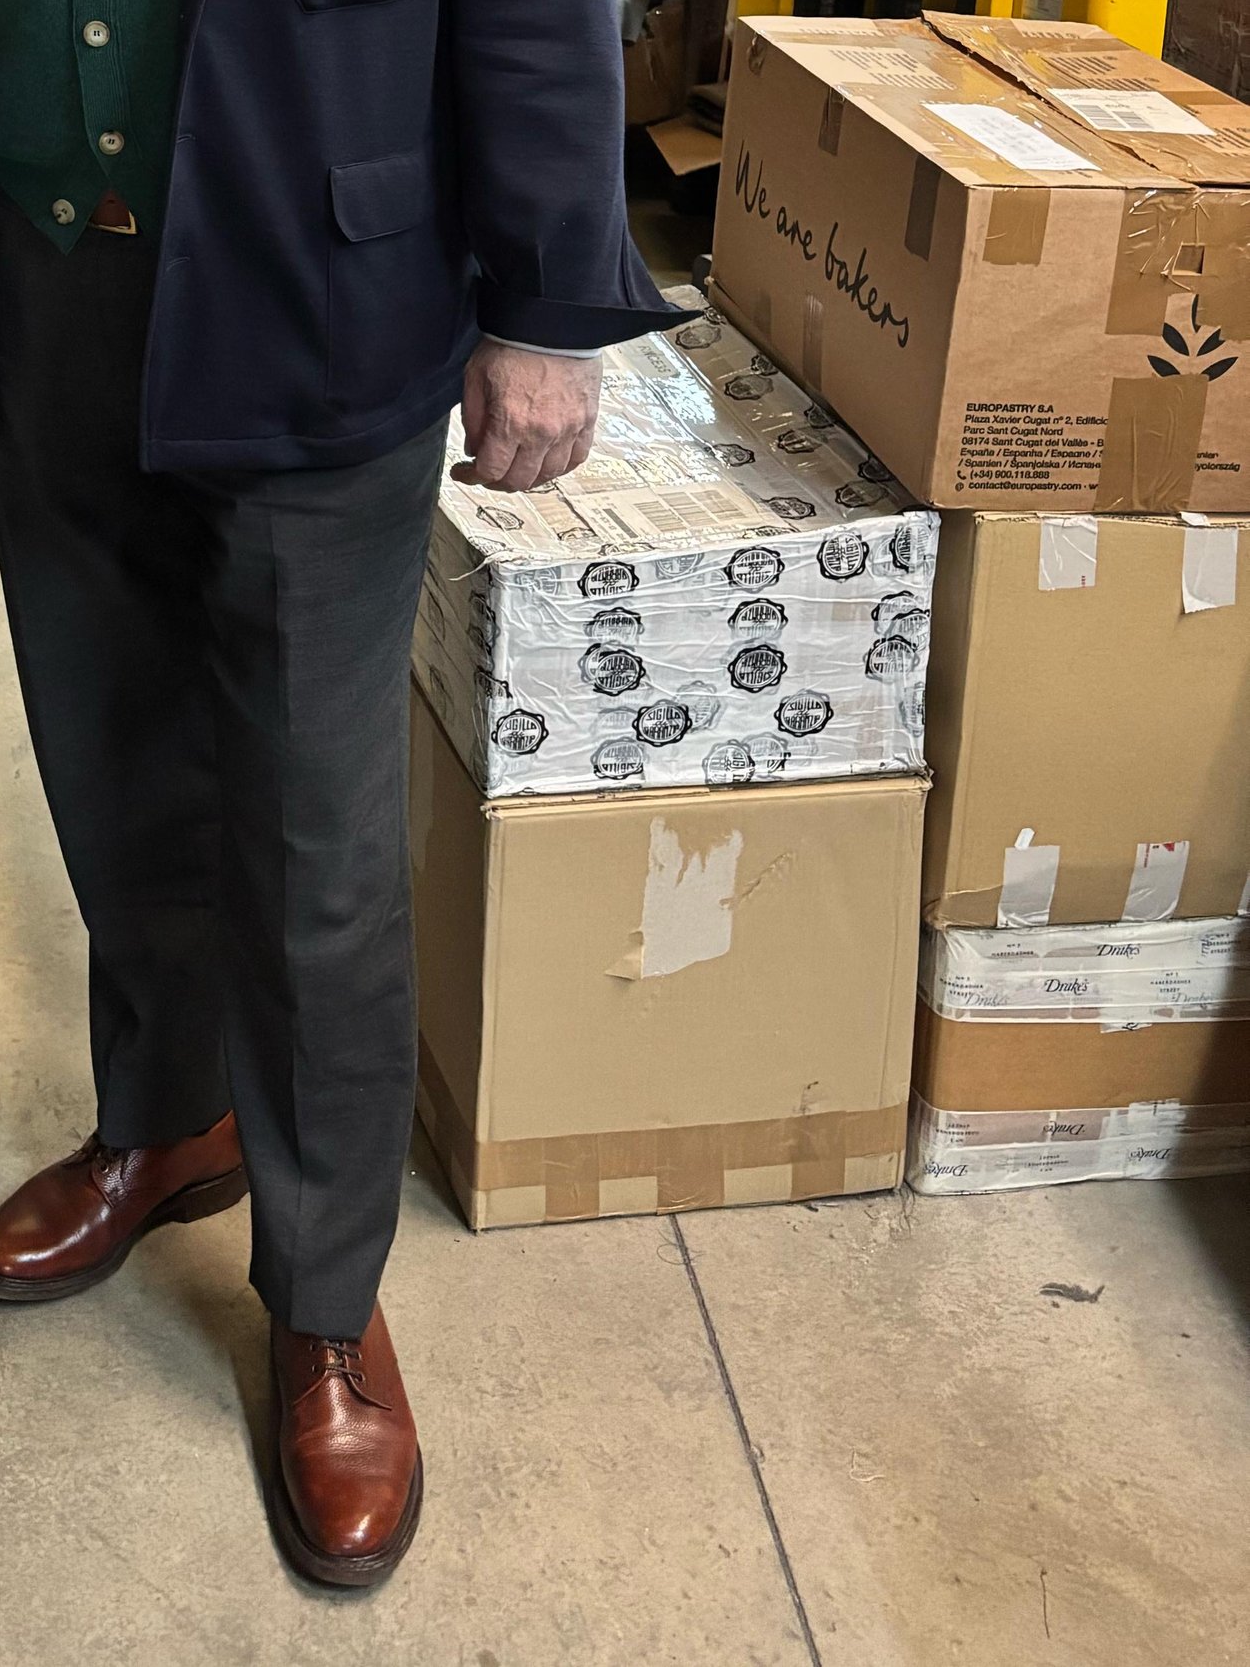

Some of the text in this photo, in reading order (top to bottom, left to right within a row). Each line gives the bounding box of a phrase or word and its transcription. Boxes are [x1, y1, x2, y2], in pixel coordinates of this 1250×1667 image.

[736, 140, 909, 348] We are bakers
[966, 403, 1054, 413] EUROPASTRY S.A
[965, 414, 990, 423] Plaza
[992, 415, 1021, 424] Xavier
[1023, 416, 1050, 426] Cugat
[963, 426, 1063, 437] Parc Sant Cugat Nord
[961, 437, 989, 445] 08174
[991, 438, 1013, 446] Sant
[1015, 438, 1042, 449] Cugat
[970, 470, 992, 479] (+34)
